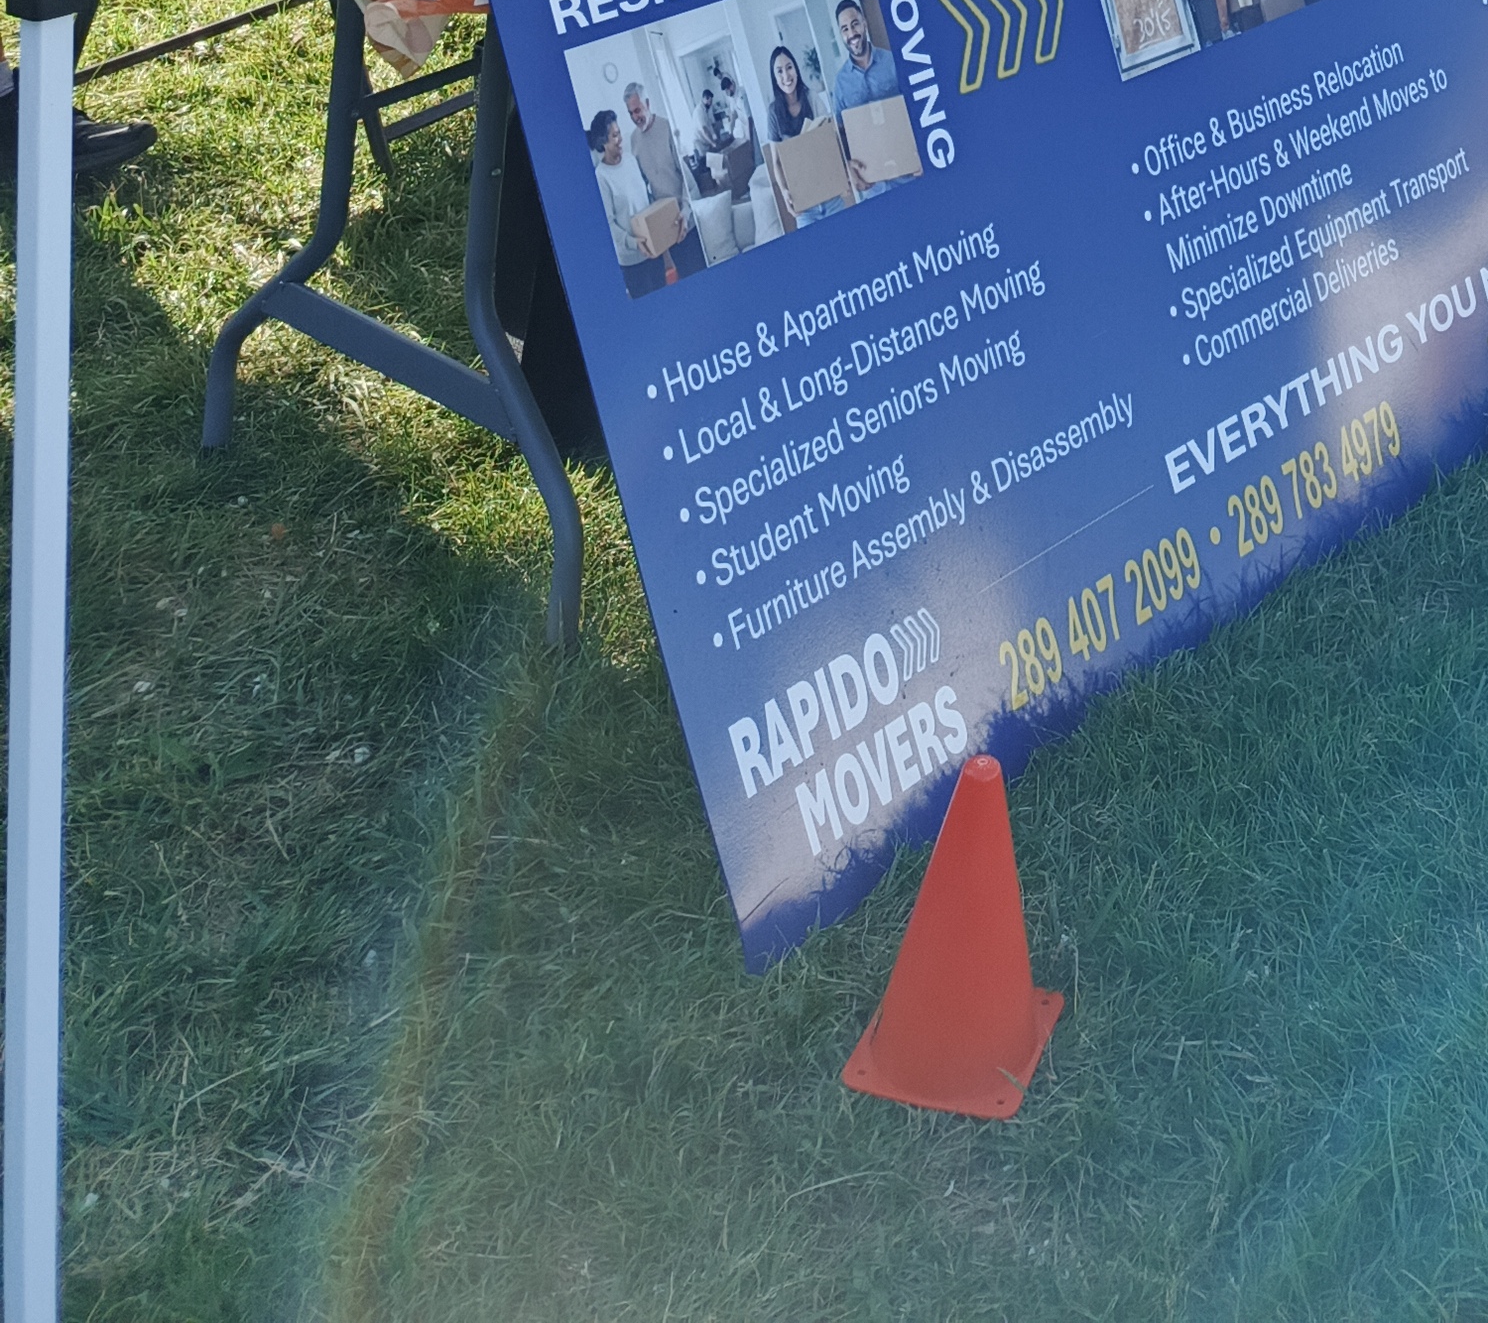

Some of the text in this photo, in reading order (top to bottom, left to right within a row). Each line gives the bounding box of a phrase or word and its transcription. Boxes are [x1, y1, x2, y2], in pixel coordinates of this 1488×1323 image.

[1143, 41, 1405, 176] Office & Business Relocation
[1159, 66, 1448, 226] After-Hours & Weekend Moves to
[1165, 163, 1354, 274] Minimize Downtime
[1181, 147, 1470, 321] Specialized Equipment Transport
[1194, 237, 1400, 367] Commercial Deliveries
[661, 222, 1001, 403] House & Apartment Moving
[678, 260, 1046, 464] Local & Long-Distance Moving
[1164, 323, 1405, 495] EVERYTHING
[1405, 275, 1478, 345] YOU
[694, 330, 1026, 525] Specialized Seniors Moving
[710, 455, 911, 587] Student Moving
[726, 393, 1135, 651] Furniture Assembly & Disassembly
[999, 400, 1402, 713] 289 407 2099 289 783 4979
[727, 632, 969, 857] RAPIDO MOVERS
